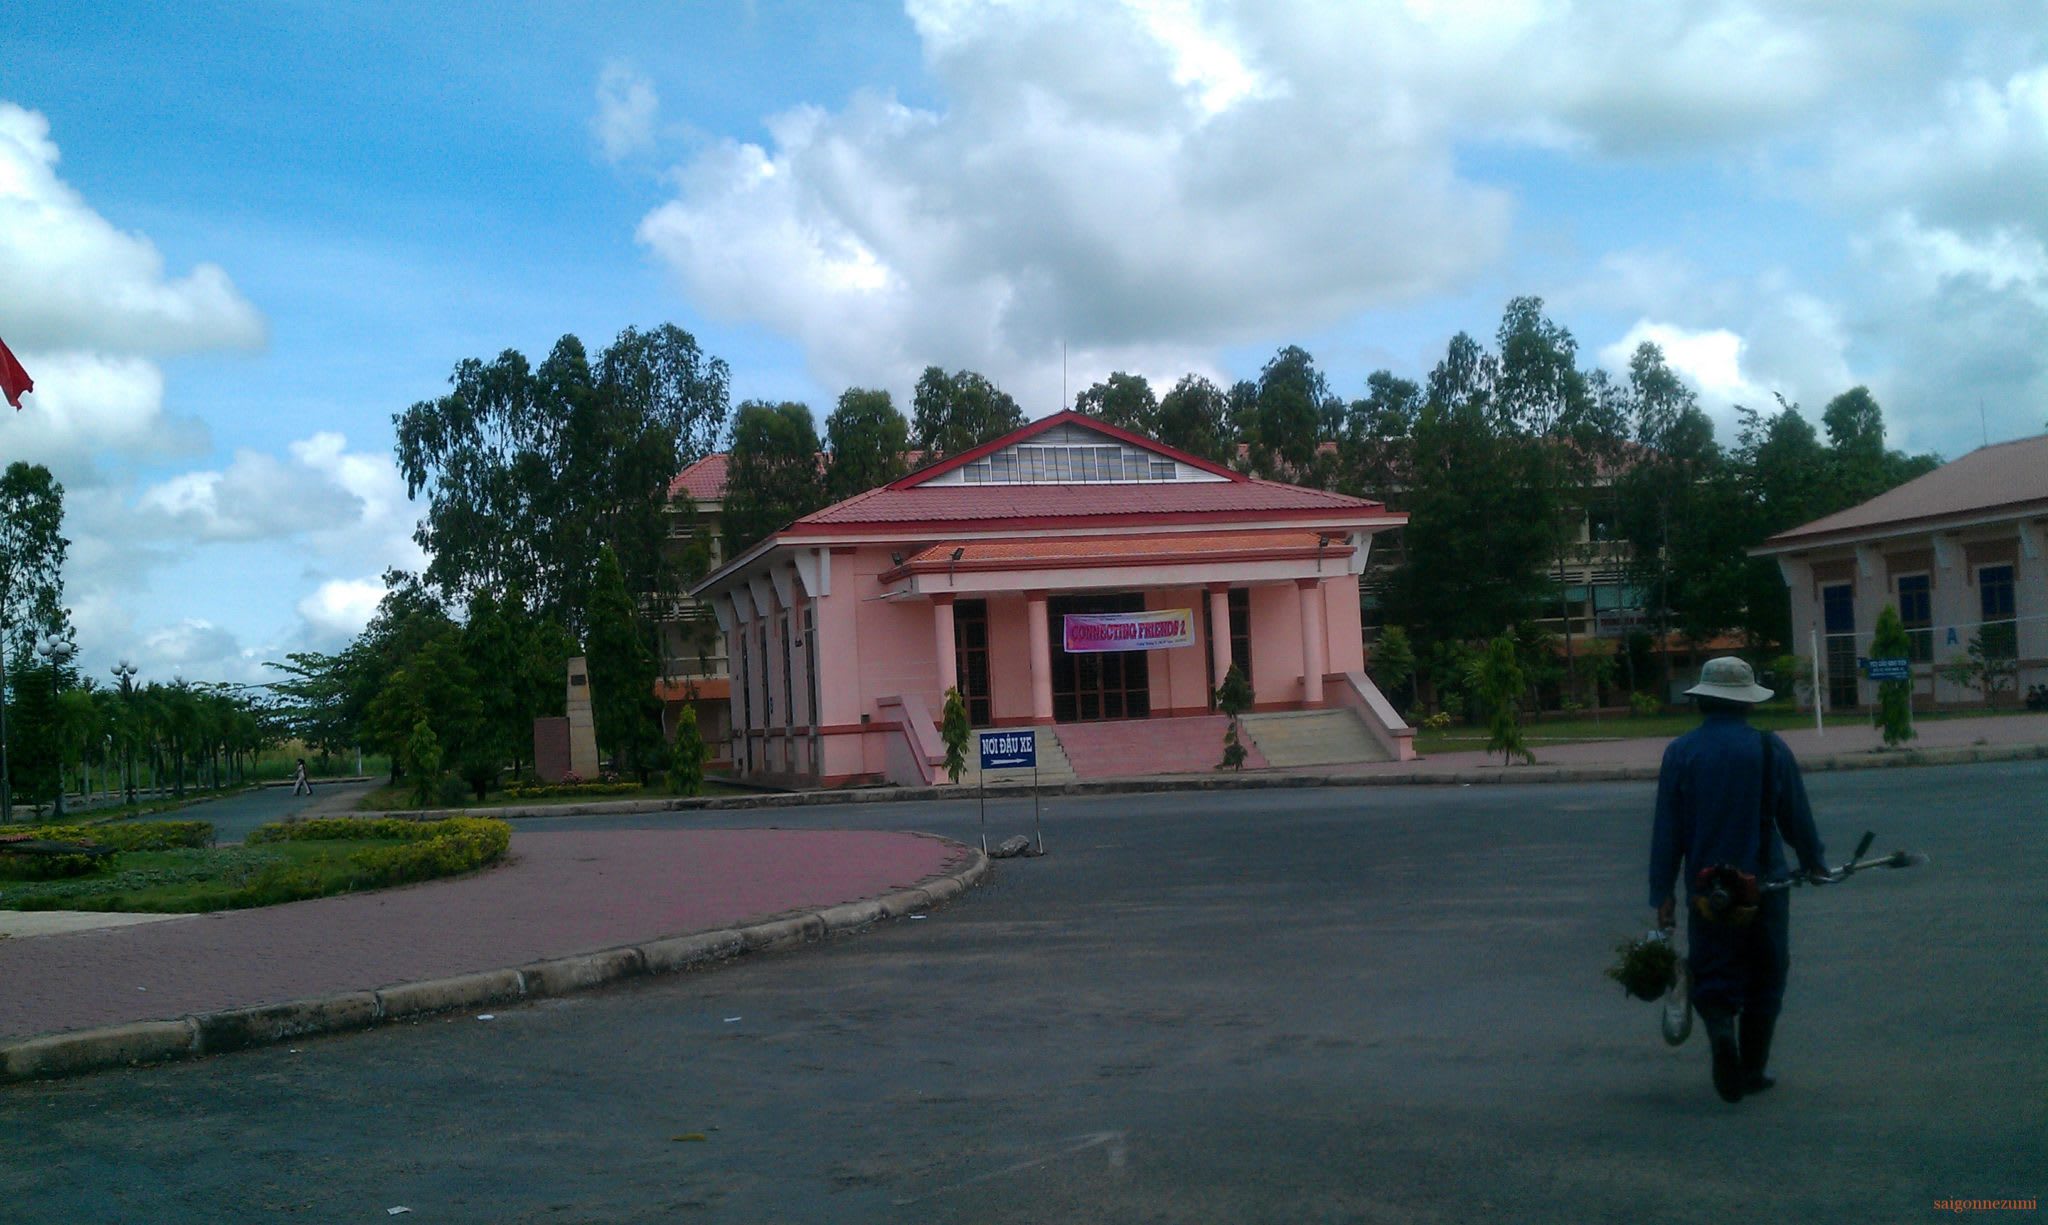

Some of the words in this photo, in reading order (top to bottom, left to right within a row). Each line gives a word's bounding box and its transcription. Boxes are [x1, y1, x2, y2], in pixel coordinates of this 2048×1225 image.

[1071, 623, 1137, 641] CONNECTING
[1139, 620, 1178, 639] FRIENDS
[1179, 620, 1186, 636] 2
[999, 733, 1019, 757] ĐẬU
[1020, 736, 1033, 753] XE
